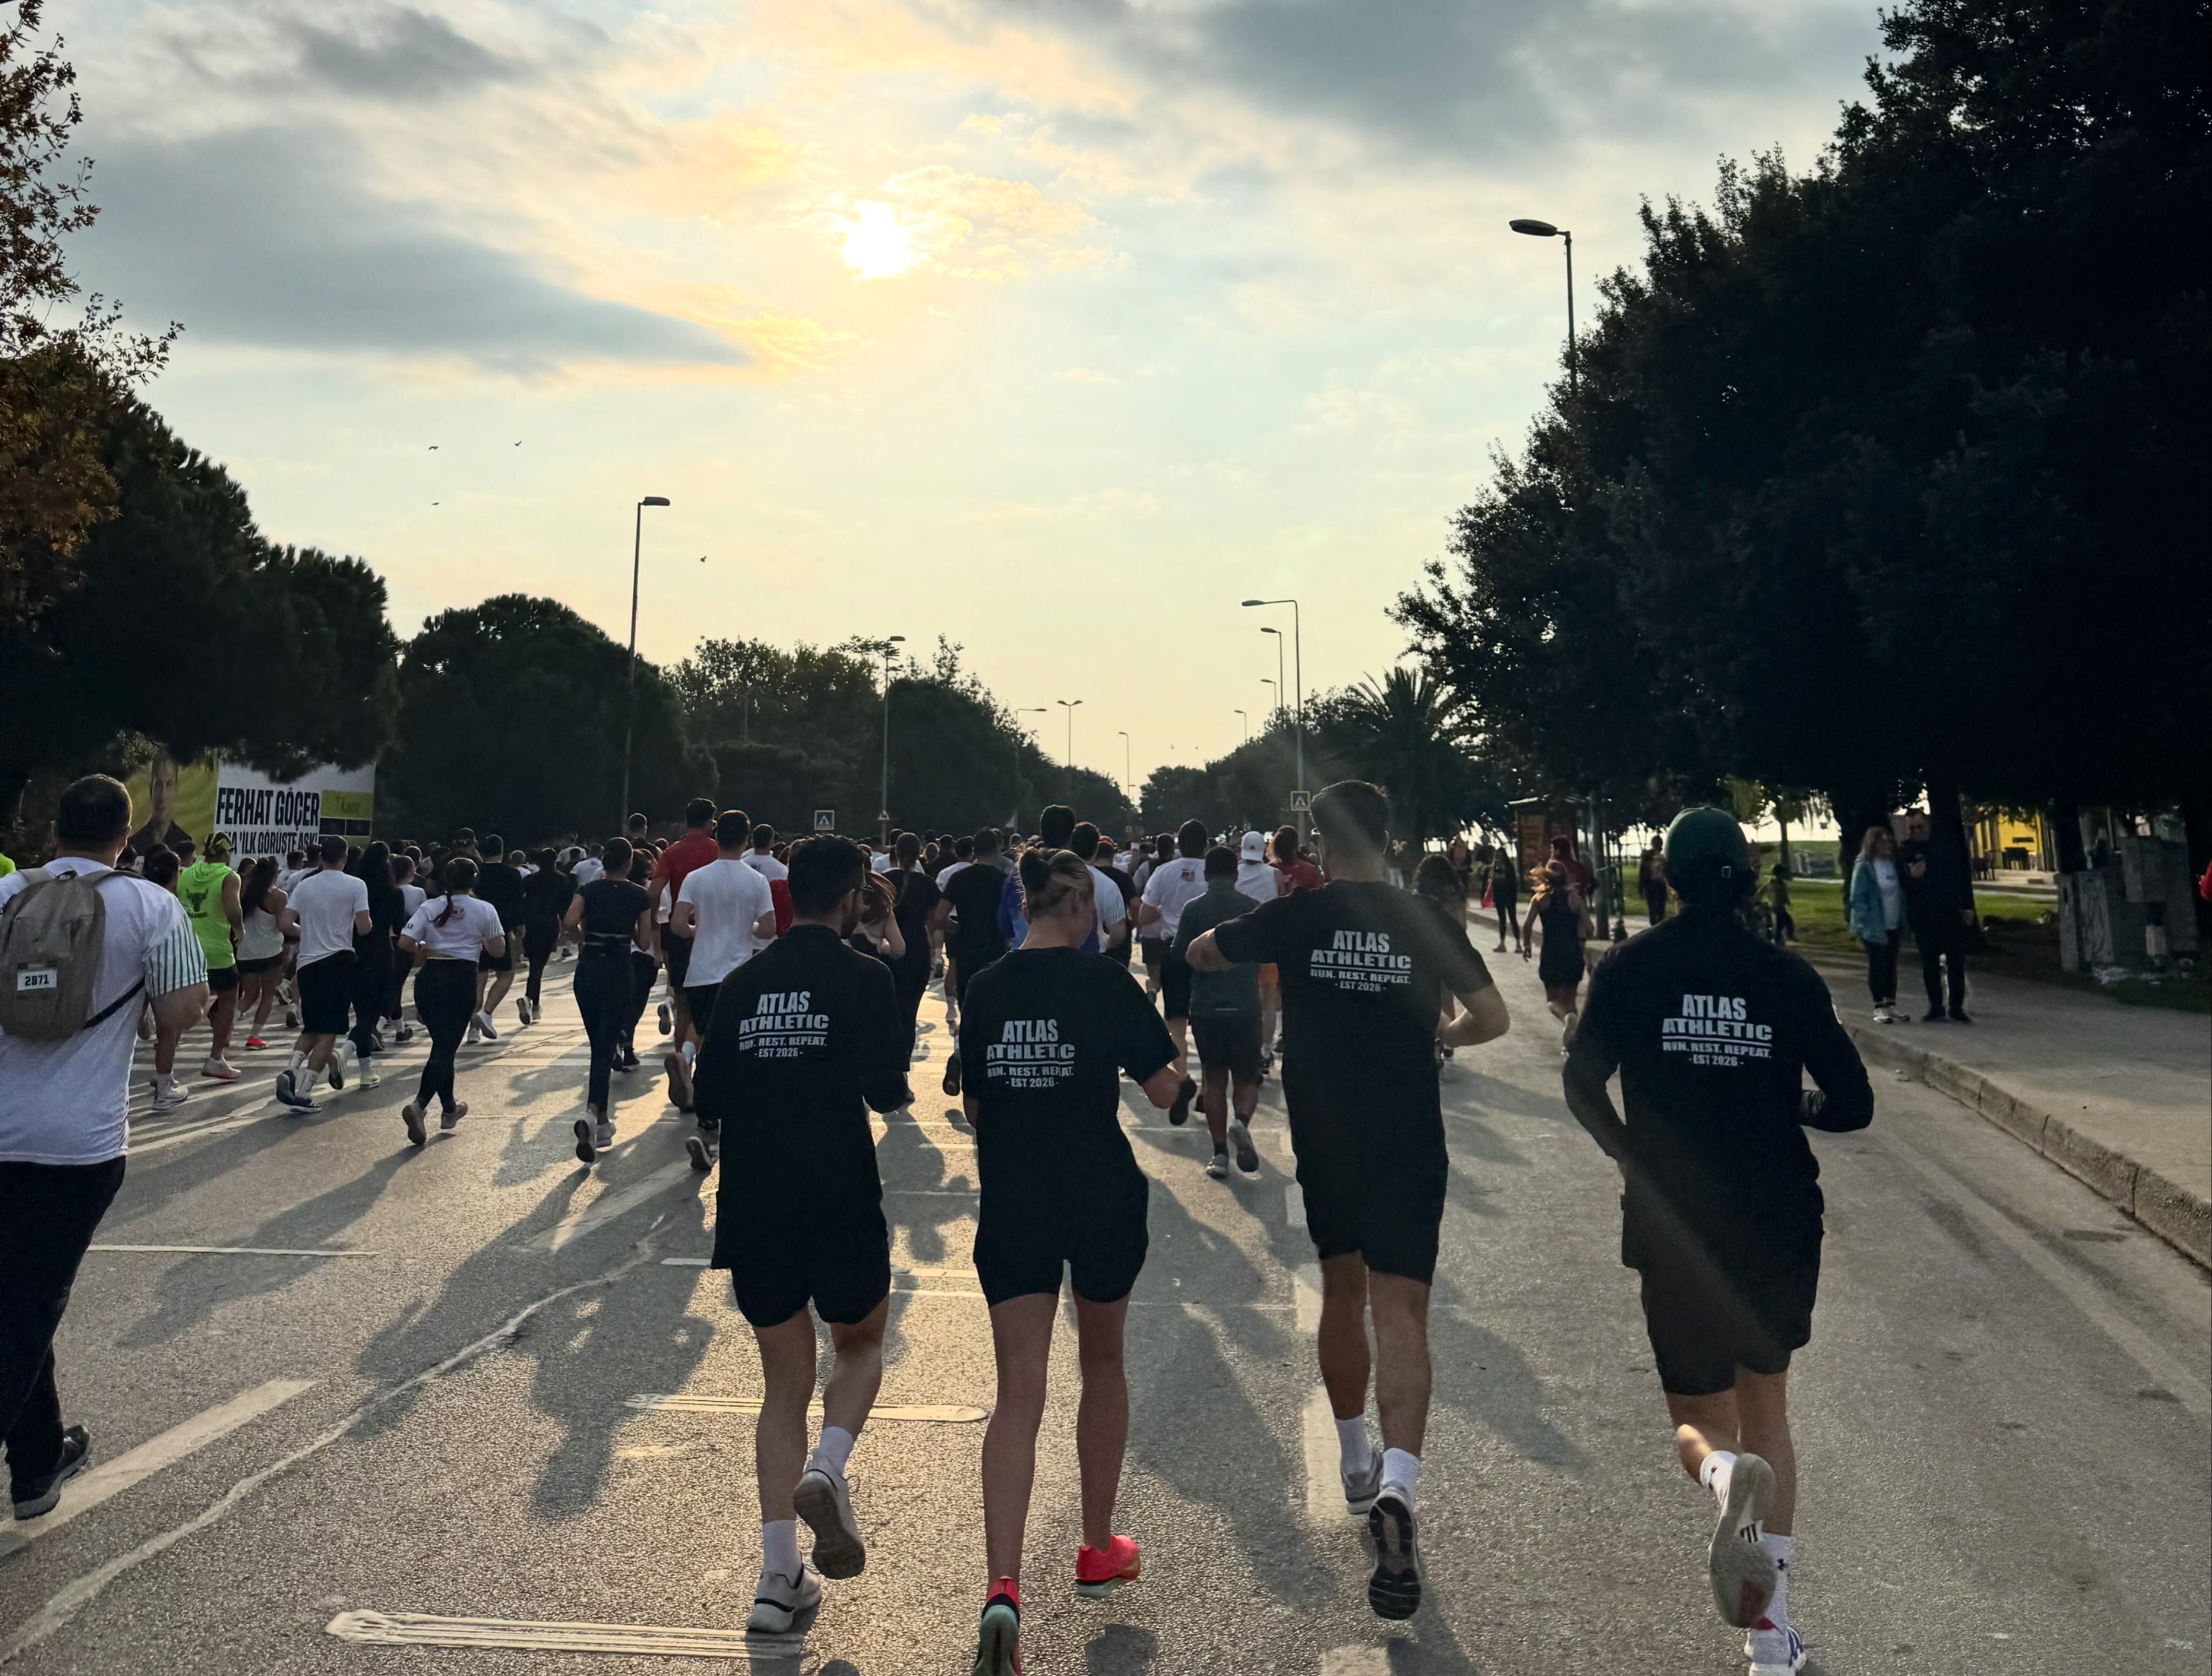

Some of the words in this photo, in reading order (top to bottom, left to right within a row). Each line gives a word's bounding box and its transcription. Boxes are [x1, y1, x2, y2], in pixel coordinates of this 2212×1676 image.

[216, 787, 273, 825] FERHAT
[275, 786, 320, 831] GÖÇER
[1332, 930, 1390, 953] ATLAS
[1311, 949, 1412, 969] ATHLETIC
[25, 974, 49, 986] 2871
[1339, 971, 1367, 980] REST.
[756, 991, 811, 1015] ATLAS
[1682, 994, 1746, 1020] ATLAS
[739, 1014, 830, 1034] ATHLETIC
[1002, 1019, 1058, 1042] ATLAS
[1662, 1018, 1772, 1040] ATHLETIC
[759, 1037, 786, 1046] REST.
[788, 1036, 827, 1046] REPEAT.
[1691, 1042, 1722, 1053] REST.
[1724, 1045, 1772, 1058] REPEAT.
[1009, 1066, 1040, 1076] REST.
